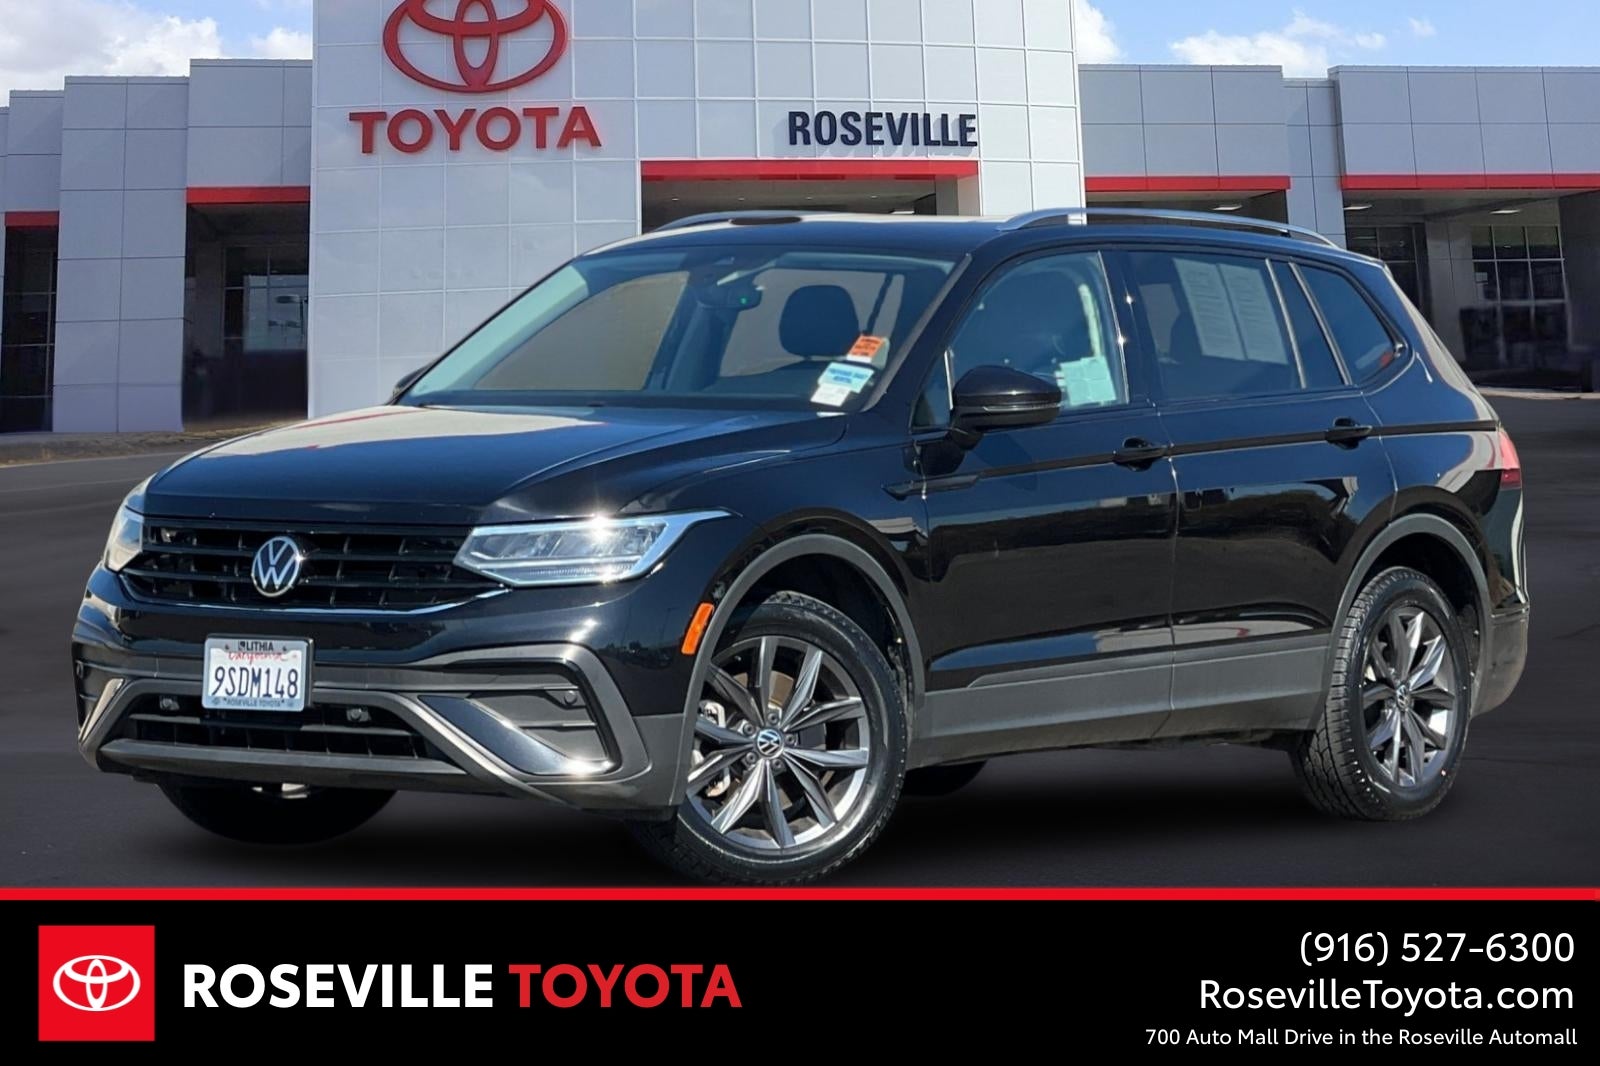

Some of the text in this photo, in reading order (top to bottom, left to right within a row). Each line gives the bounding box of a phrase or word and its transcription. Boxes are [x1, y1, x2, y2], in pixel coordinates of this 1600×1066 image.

[350, 106, 602, 154] TOYOTA
[789, 111, 978, 147] ROSEVILLE
[246, 641, 274, 651] LITHIA
[211, 666, 299, 699] 9SDM148
